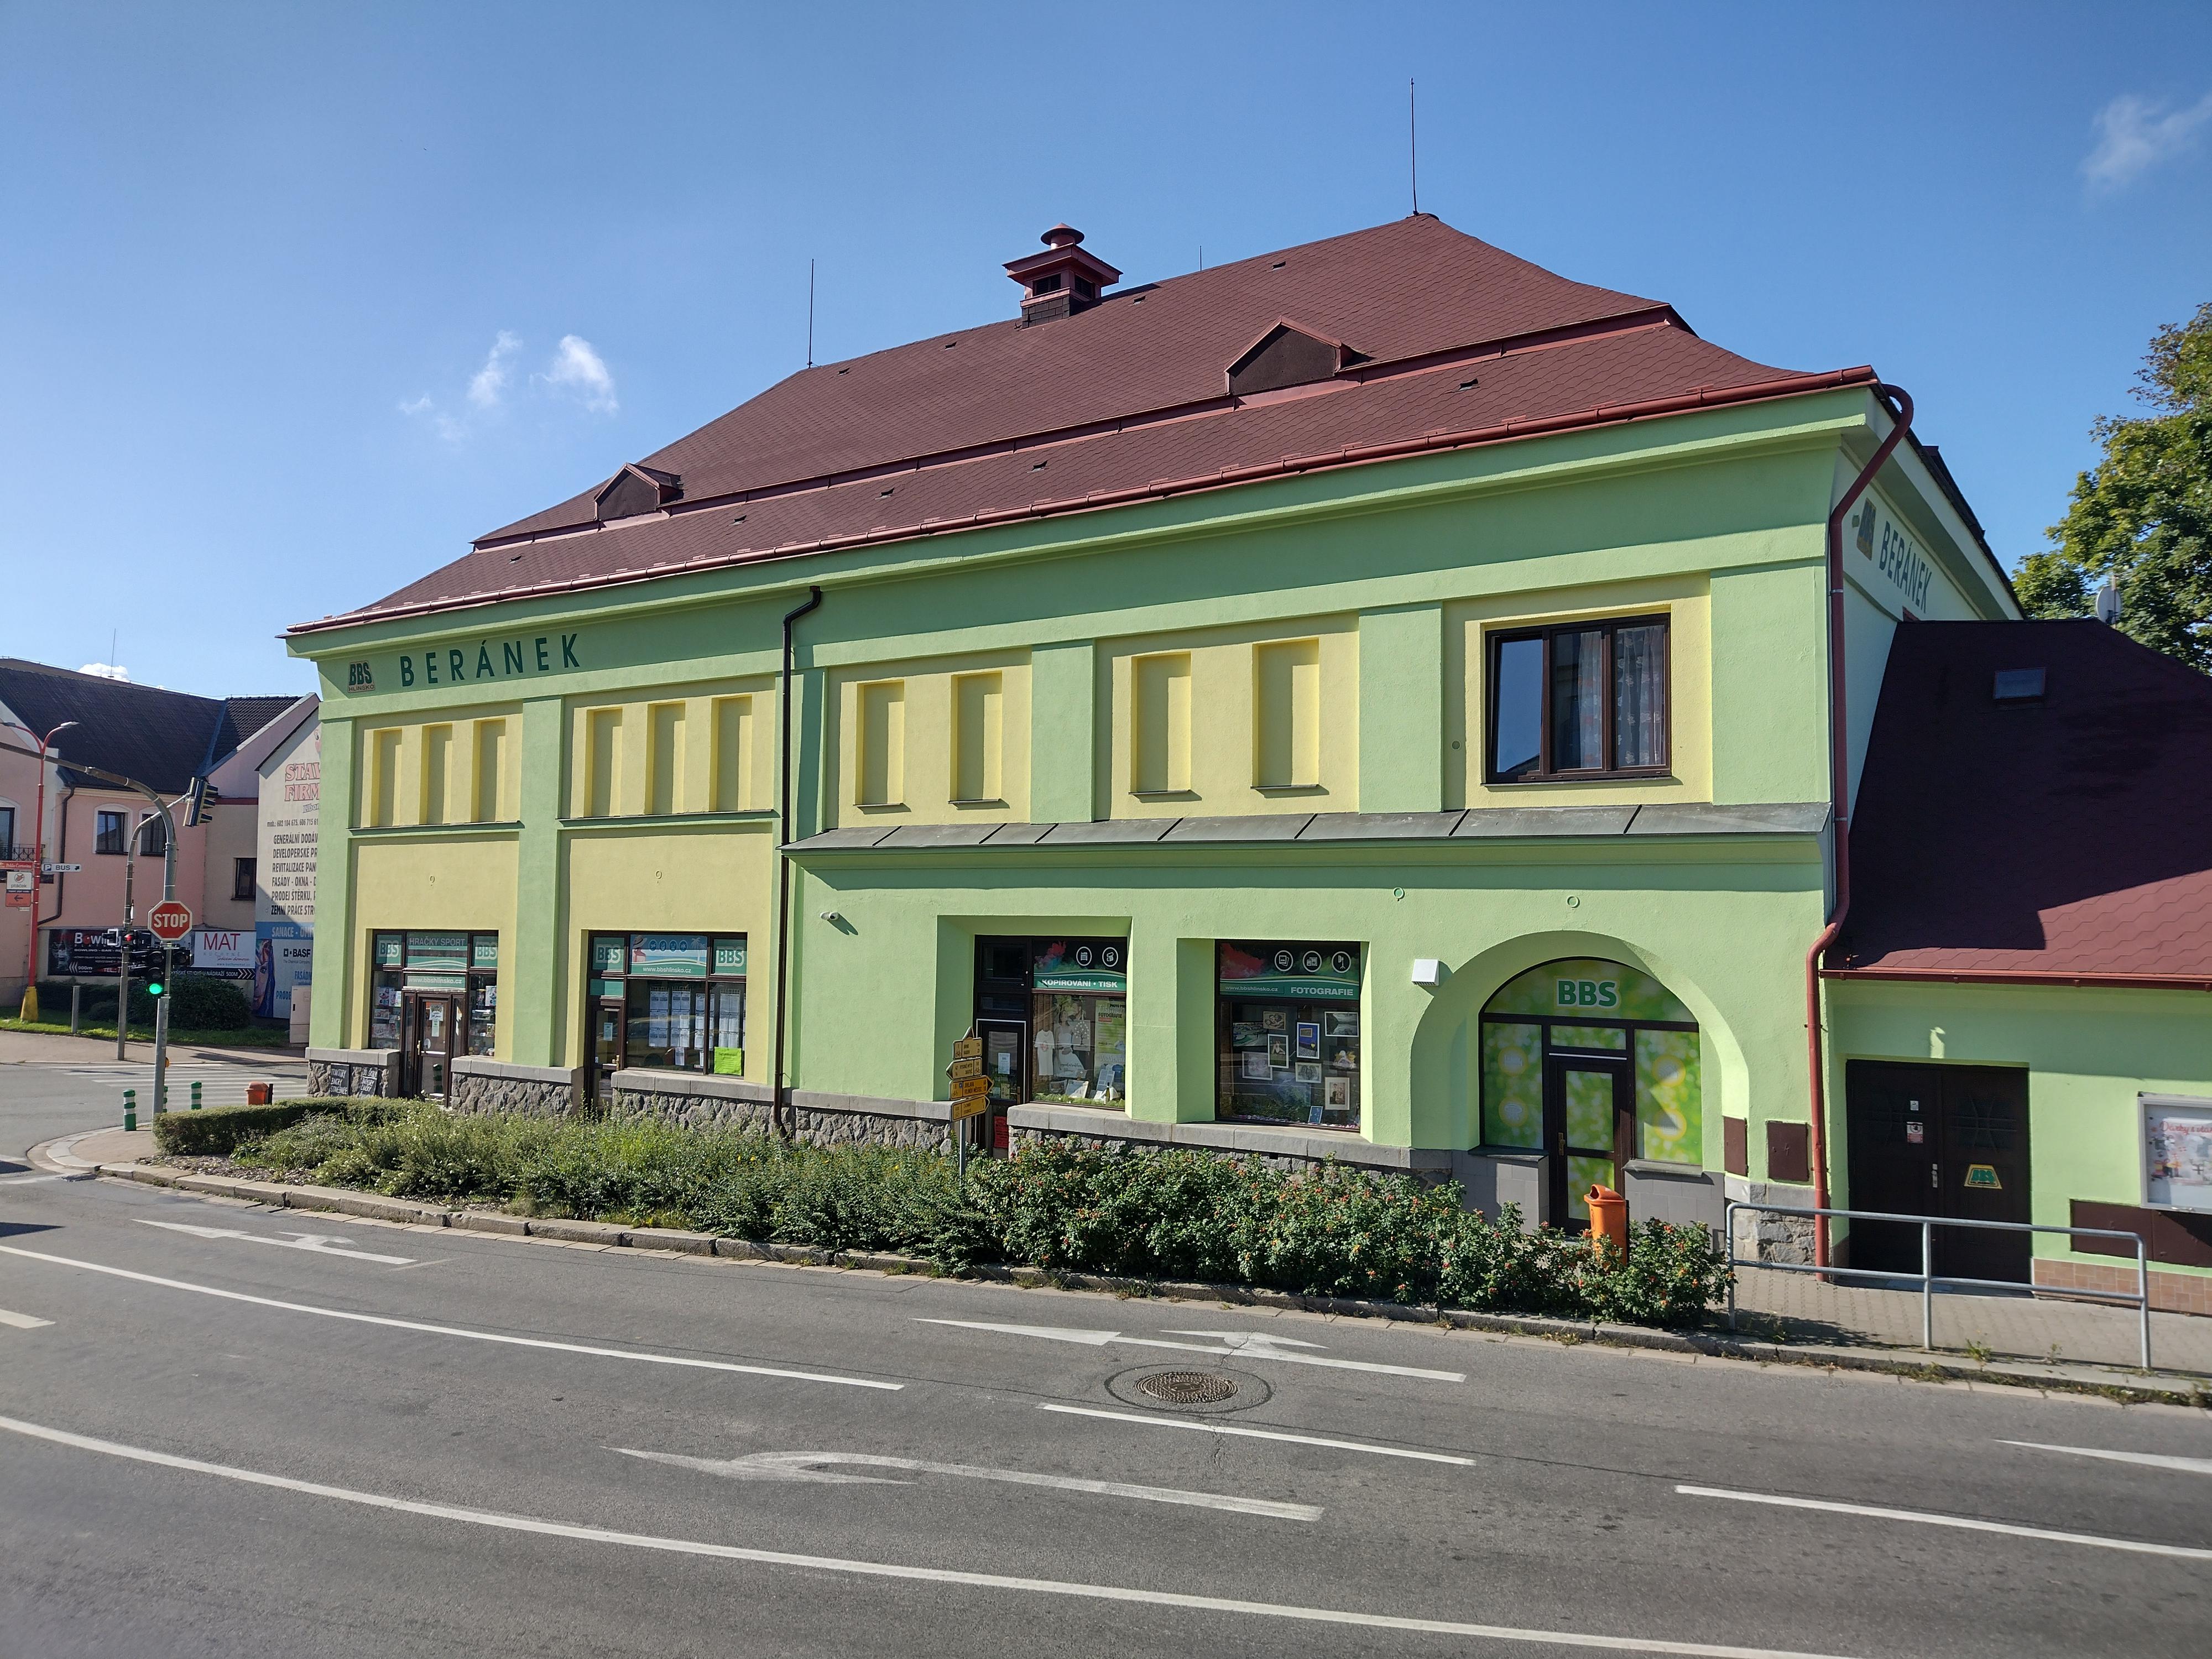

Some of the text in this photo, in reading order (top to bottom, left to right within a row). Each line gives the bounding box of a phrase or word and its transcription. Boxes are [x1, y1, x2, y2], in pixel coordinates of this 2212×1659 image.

[1879, 520, 1932, 613] BERÁNEK
[400, 634, 580, 687] BERÁNEK
[349, 662, 372, 686] BBS
[274, 832, 300, 844] GENERÁLNÍ
[273, 846, 309, 858] DEVELOPERSKÉ
[273, 862, 304, 872] REVITALIZACE
[272, 875, 290, 886] FASÁDY
[295, 877, 309, 886] OKNA
[272, 891, 290, 901] PRODEJ
[271, 903, 315, 915] ZEMNÍ PRÁCE STR
[154, 914, 188, 928] STOP
[272, 926, 294, 937] SANACE
[204, 933, 241, 951] MAT
[409, 936, 466, 947] HRAČKY SPORT
[293, 948, 311, 957] BASF
[379, 942, 398, 956] BBS
[477, 944, 496, 958] BBS
[597, 946, 619, 961] BBS
[719, 948, 742, 964] BBS
[1042, 978, 1091, 987] KOPÍROVÁNÍ
[1291, 987, 1354, 995] FOTOGRAFIE
[1558, 980, 1617, 1006] BBS
